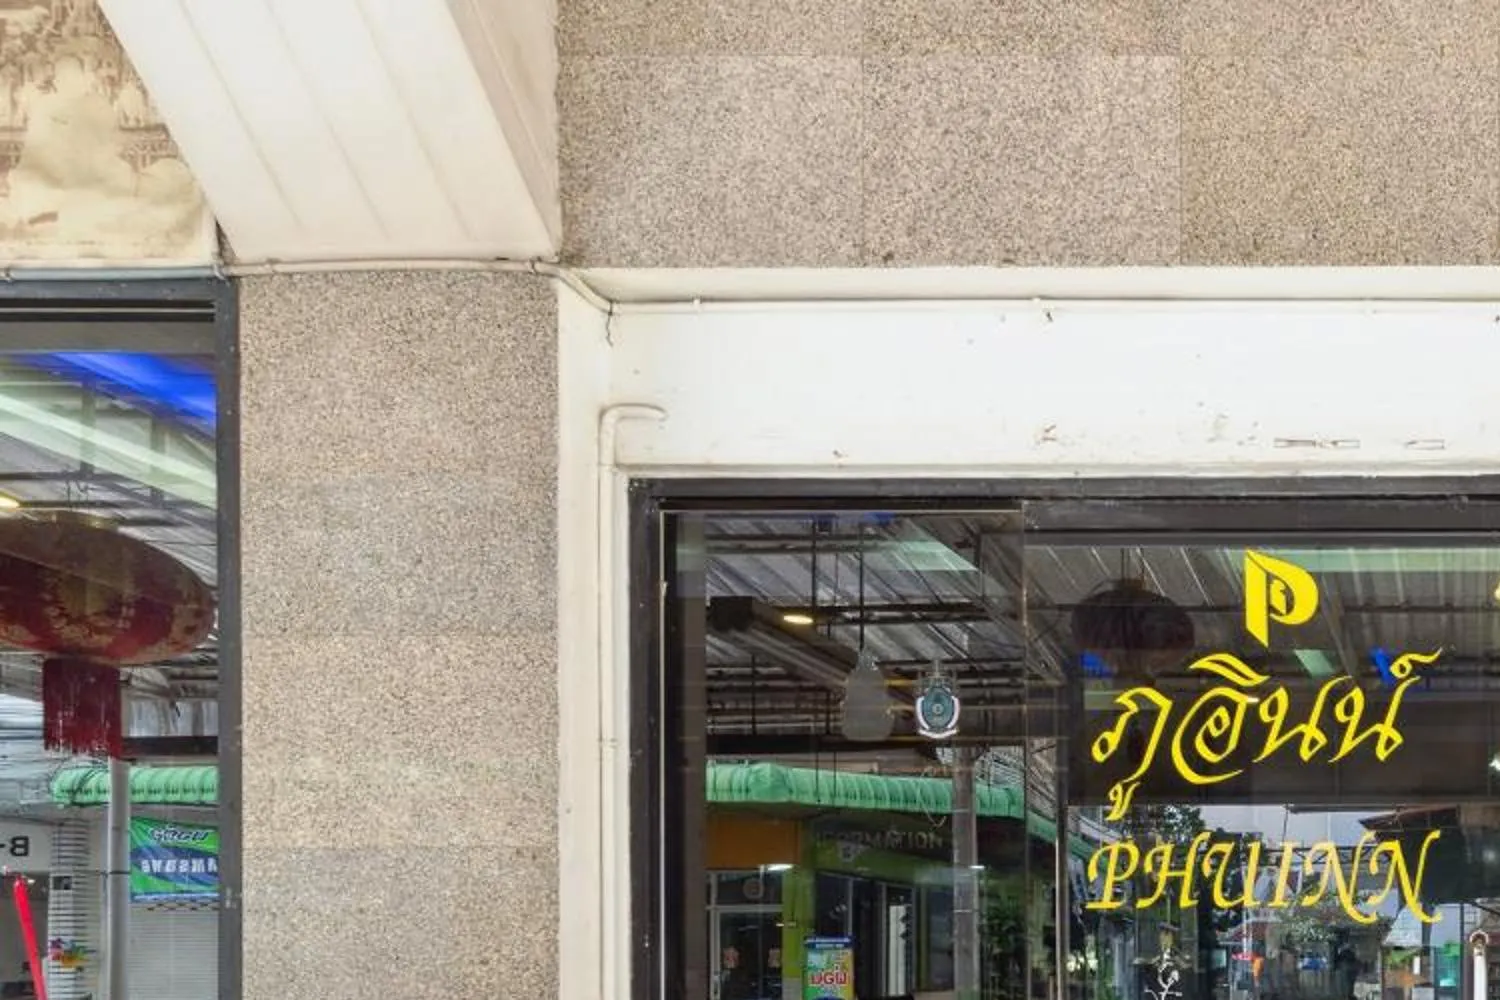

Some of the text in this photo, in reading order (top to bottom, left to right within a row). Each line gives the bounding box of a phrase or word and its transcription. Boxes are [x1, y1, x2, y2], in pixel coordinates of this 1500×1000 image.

[1091, 651, 1443, 820] ภูอินน์
[1086, 830, 1442, 924] PHUINN
